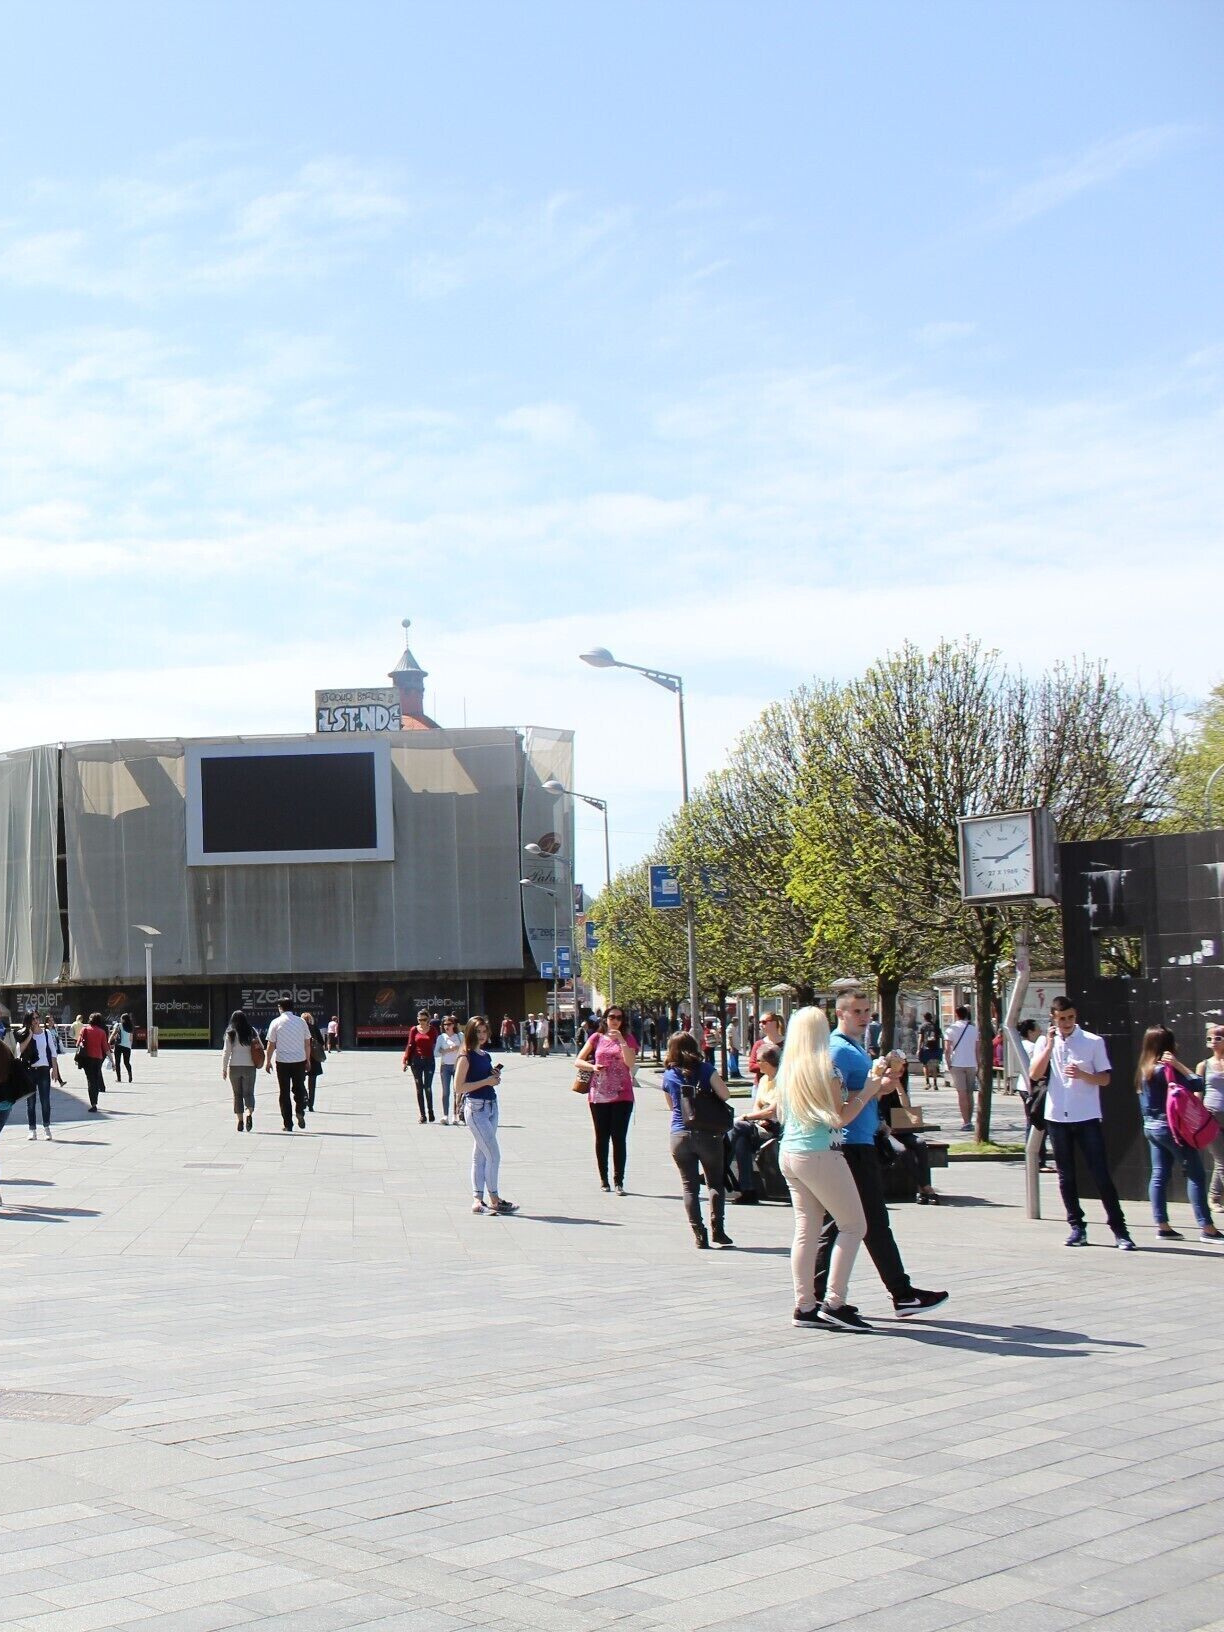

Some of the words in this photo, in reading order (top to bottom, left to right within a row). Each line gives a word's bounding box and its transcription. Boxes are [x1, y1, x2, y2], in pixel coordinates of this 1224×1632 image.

[25, 988, 63, 1007] zepter
[253, 983, 324, 1003] zepter
[153, 998, 189, 1014] zepter
[414, 995, 451, 1009] zepter
